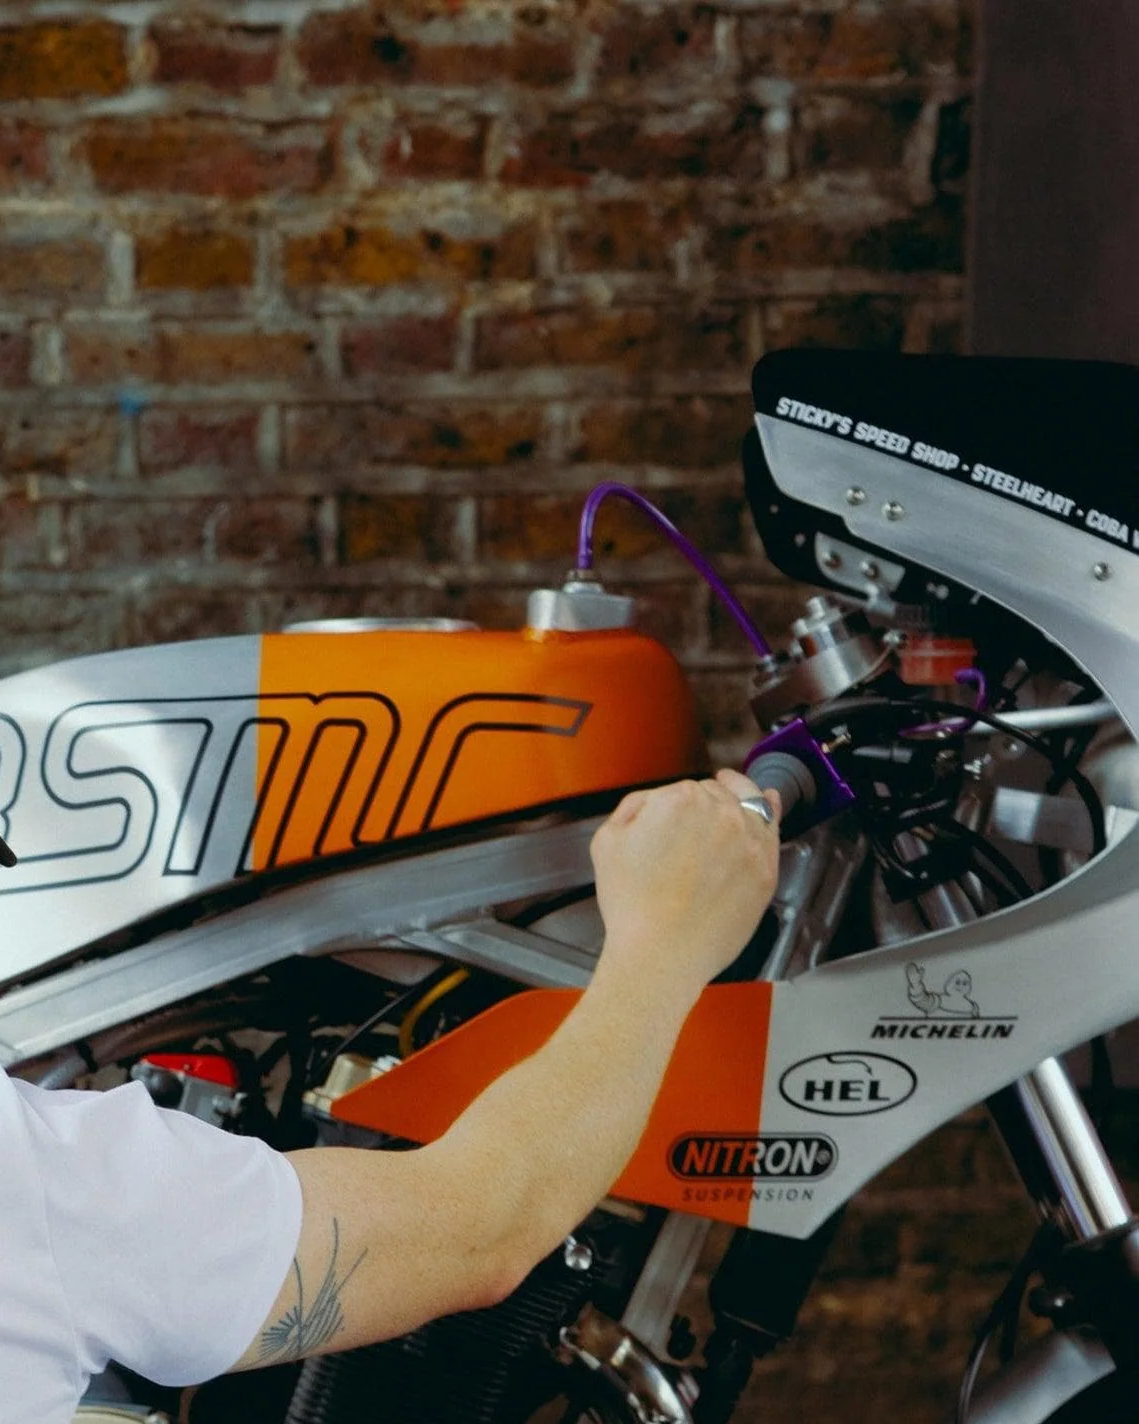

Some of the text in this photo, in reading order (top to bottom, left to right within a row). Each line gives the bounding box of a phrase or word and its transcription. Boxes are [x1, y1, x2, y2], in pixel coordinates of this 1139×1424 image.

[775, 396, 853, 436] STICKY'S
[853, 421, 911, 455] SPEED
[911, 441, 960, 470] SHOP
[971, 463, 1076, 517] STEELHEART
[870, 1023, 1015, 1039] MICHELIN
[803, 1080, 891, 1102] HEL
[681, 1139, 820, 1175] NITRON
[682, 1187, 815, 1202] SUSPENSION
